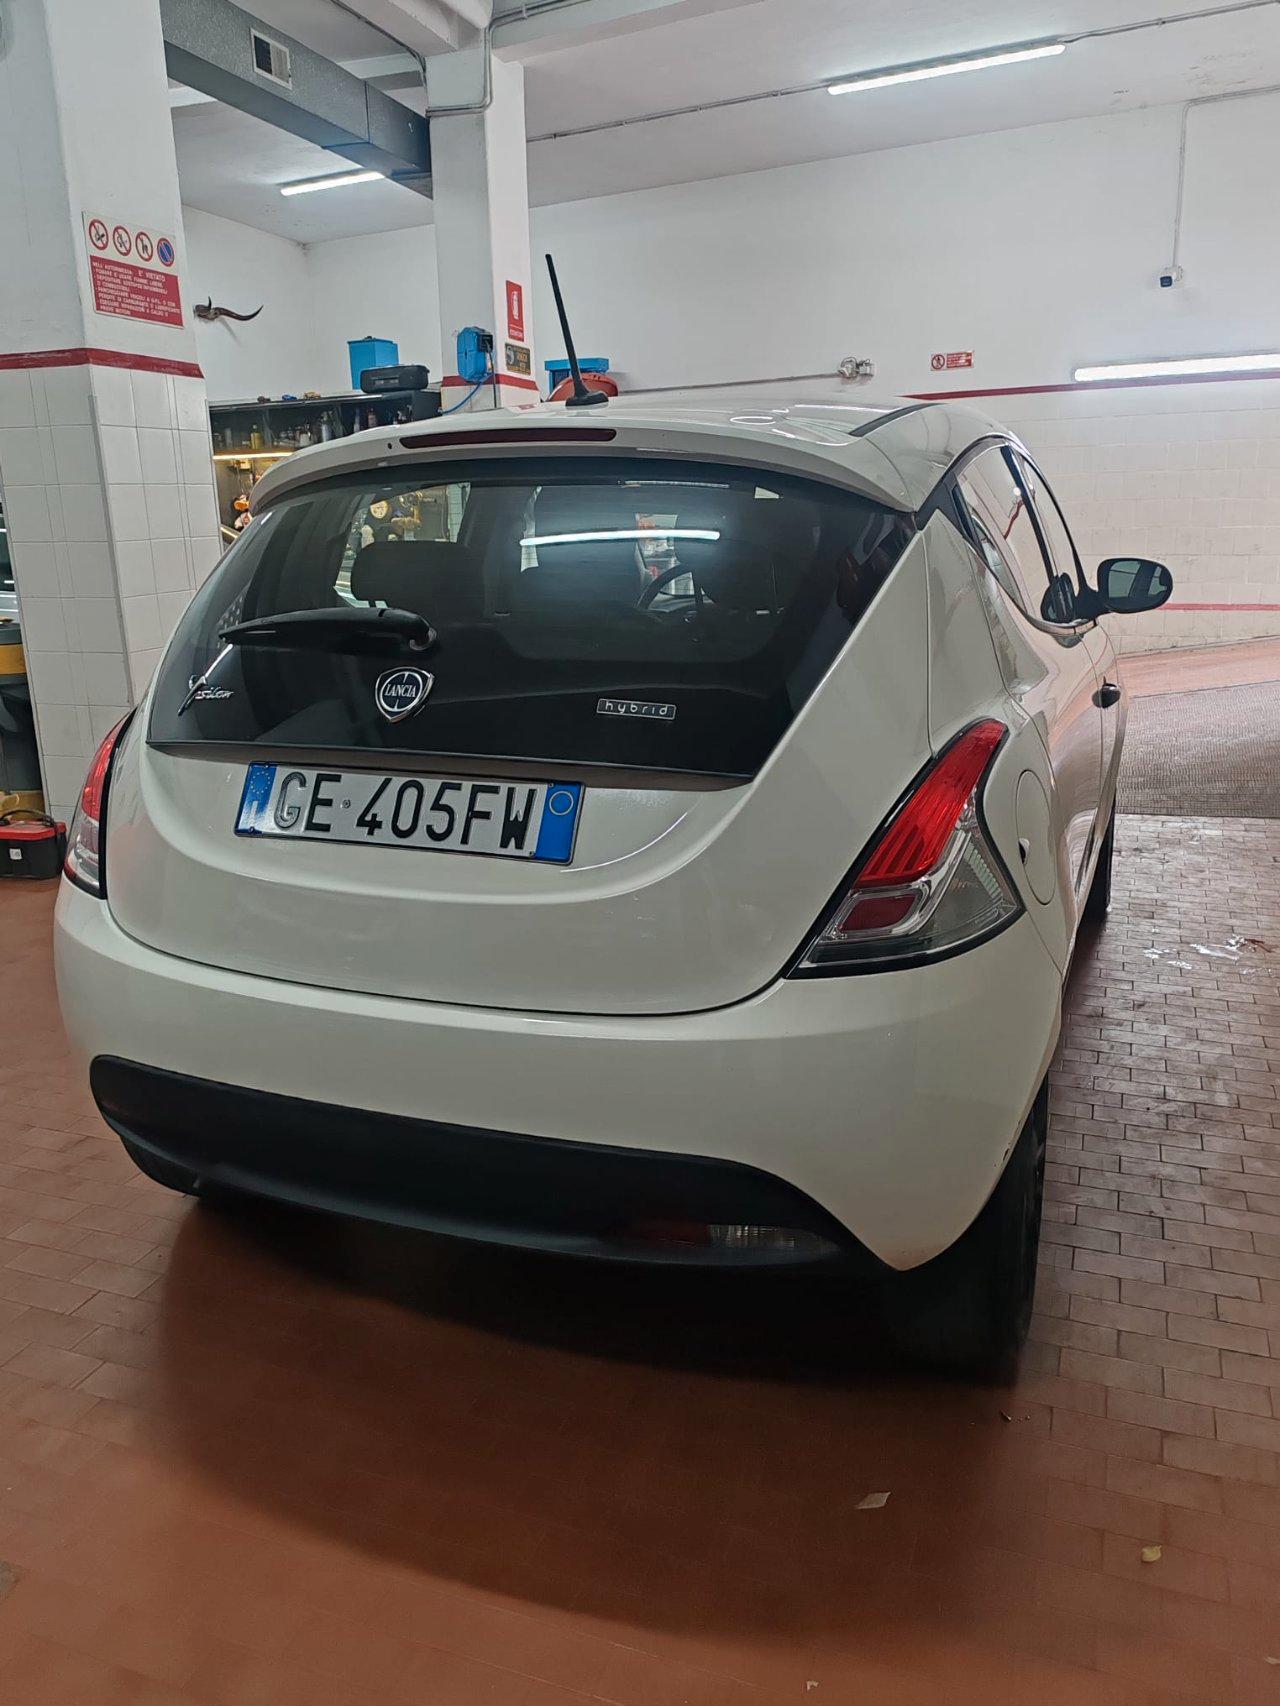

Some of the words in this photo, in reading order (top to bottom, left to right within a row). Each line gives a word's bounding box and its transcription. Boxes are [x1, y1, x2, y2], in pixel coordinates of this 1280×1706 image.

[383, 683, 417, 698] LANCIA
[605, 700, 669, 715] hybrid
[356, 776, 538, 850] 405FW
